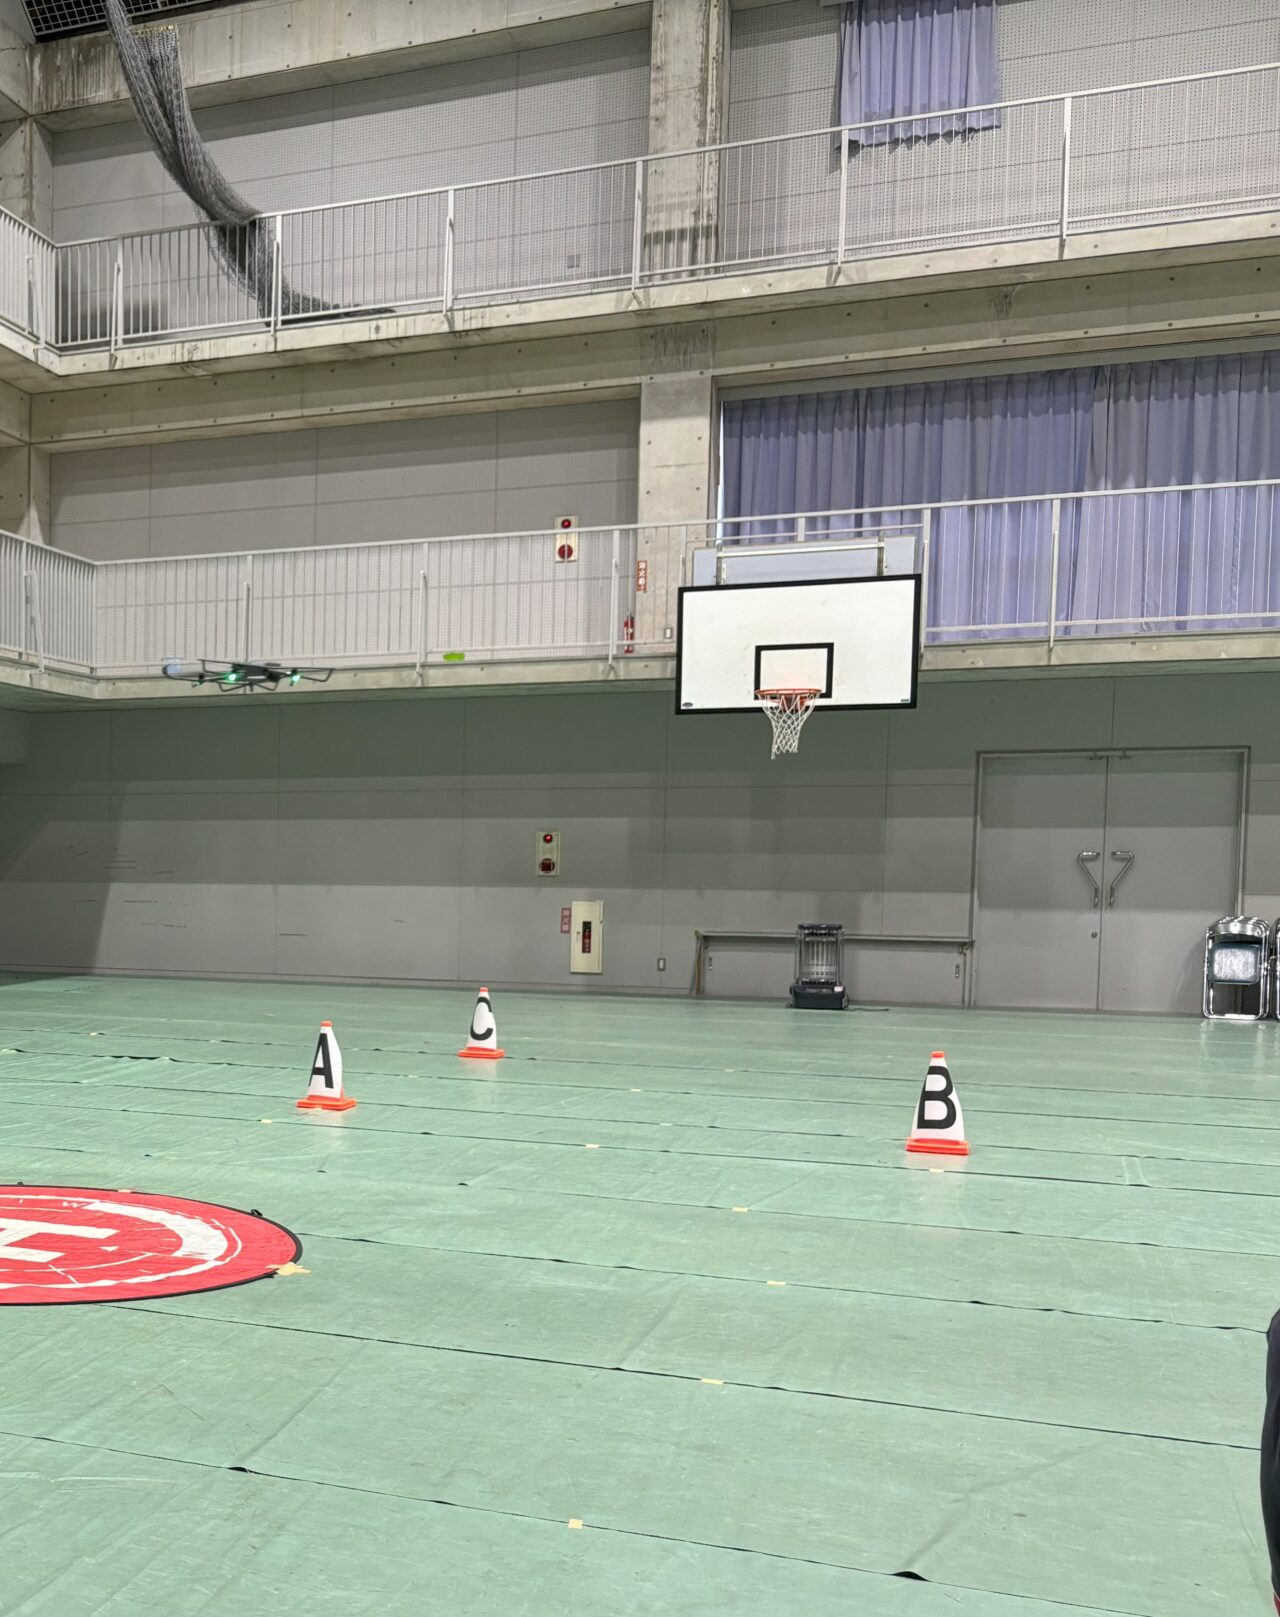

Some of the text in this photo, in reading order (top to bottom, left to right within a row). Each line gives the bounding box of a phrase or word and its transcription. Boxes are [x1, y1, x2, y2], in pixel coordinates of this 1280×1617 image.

[470, 996, 494, 1041] C
[308, 1033, 334, 1089] A
[917, 1065, 957, 1129] B
